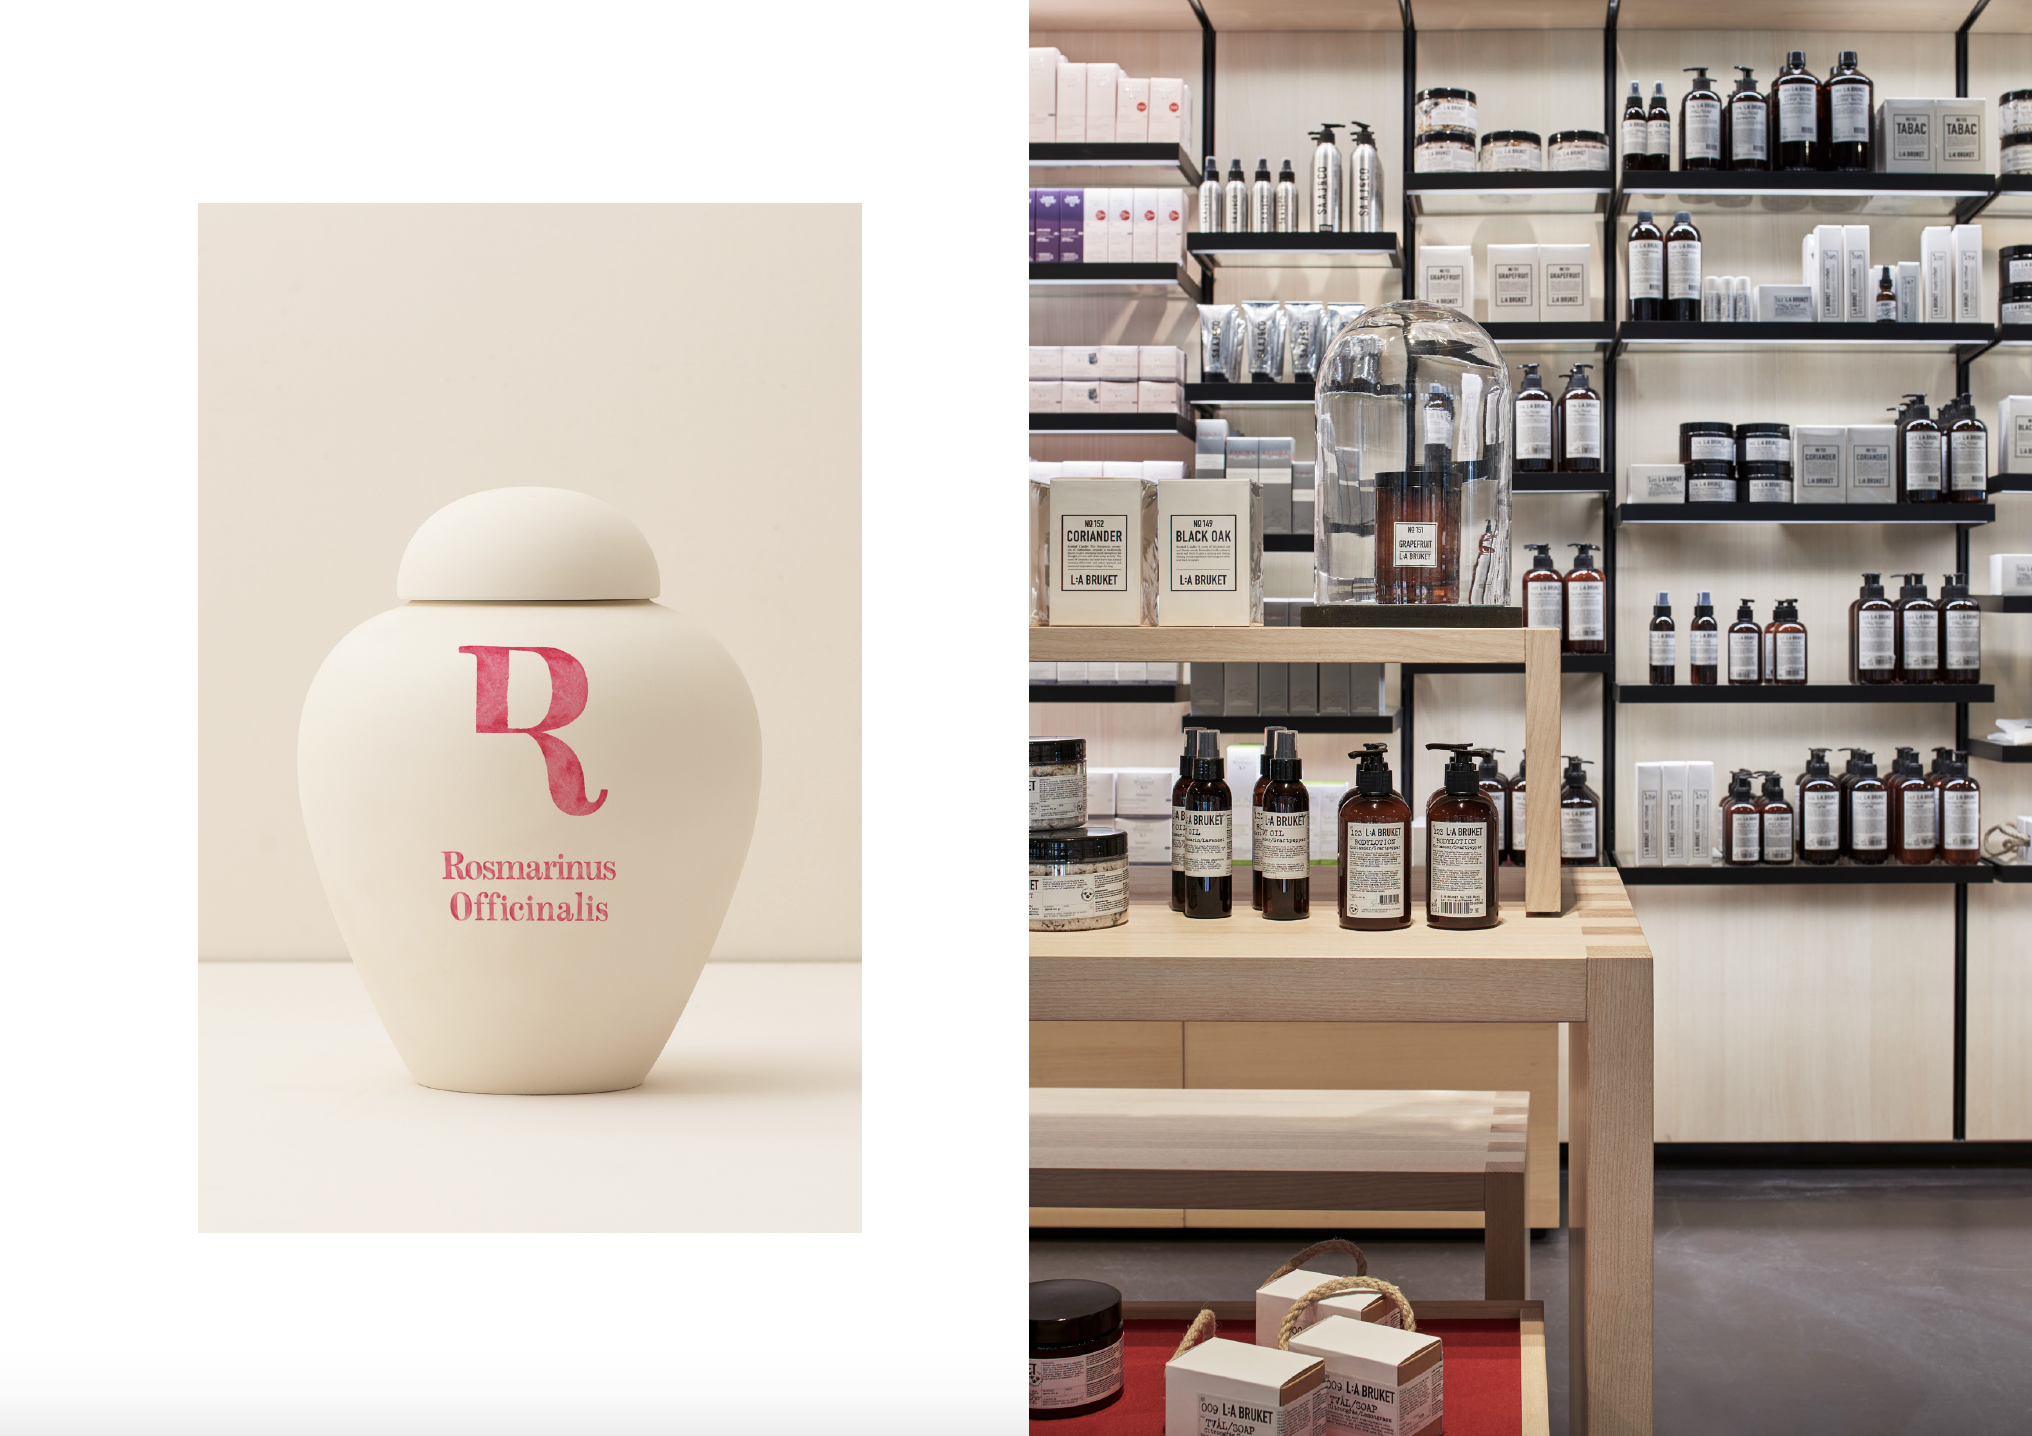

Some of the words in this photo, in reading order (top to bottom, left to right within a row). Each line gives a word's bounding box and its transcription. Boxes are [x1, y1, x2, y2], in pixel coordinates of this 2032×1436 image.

[1896, 122, 1927, 135] TABAC
[1946, 123, 1977, 135] TABAC
[1805, 453, 1837, 461] CORIANDER
[1856, 453, 1888, 461] CORIANDER
[1093, 519, 1104, 528] 152
[1202, 519, 1213, 528] 149
[1067, 530, 1123, 542] CORIANDER
[1176, 530, 1208, 542] BLACK
[1211, 530, 1231, 542] OAK
[1398, 540, 1433, 548] GRAPEFRUIT
[1070, 574, 1084, 586] L:A
[1085, 574, 1118, 586] BRUKET
[1179, 574, 1193, 586] L:A
[1194, 574, 1227, 586] BRUKET
[458, 645, 608, 816] R
[1193, 814, 1223, 826] BRUKET
[1265, 815, 1275, 826] L:A
[1276, 815, 1306, 827] BRUKET
[1188, 828, 1201, 836] OIL
[1269, 829, 1285, 837] OIL
[1350, 829, 1362, 837] 123
[1365, 828, 1376, 837] L:A
[1377, 827, 1402, 837] BRUKET
[1433, 827, 1444, 836] 123
[1446, 827, 1457, 836] L:A
[1458, 827, 1483, 836] BRUKET
[441, 851, 617, 881] Rosmarinus
[450, 891, 609, 922] Officinalis
[1291, 1326, 1303, 1335] 00
[1326, 1379, 1343, 1392] 009
[1346, 1381, 1360, 1396] L:A
[1361, 1384, 1396, 1405] BRUKET
[1329, 1395, 1378, 1414] TVÅL/SOAP
[1201, 1402, 1219, 1415] 009
[1222, 1402, 1237, 1418] L:A
[1238, 1405, 1274, 1425] BRUKET
[1205, 1418, 1255, 1435] TVÅL/SOAP
